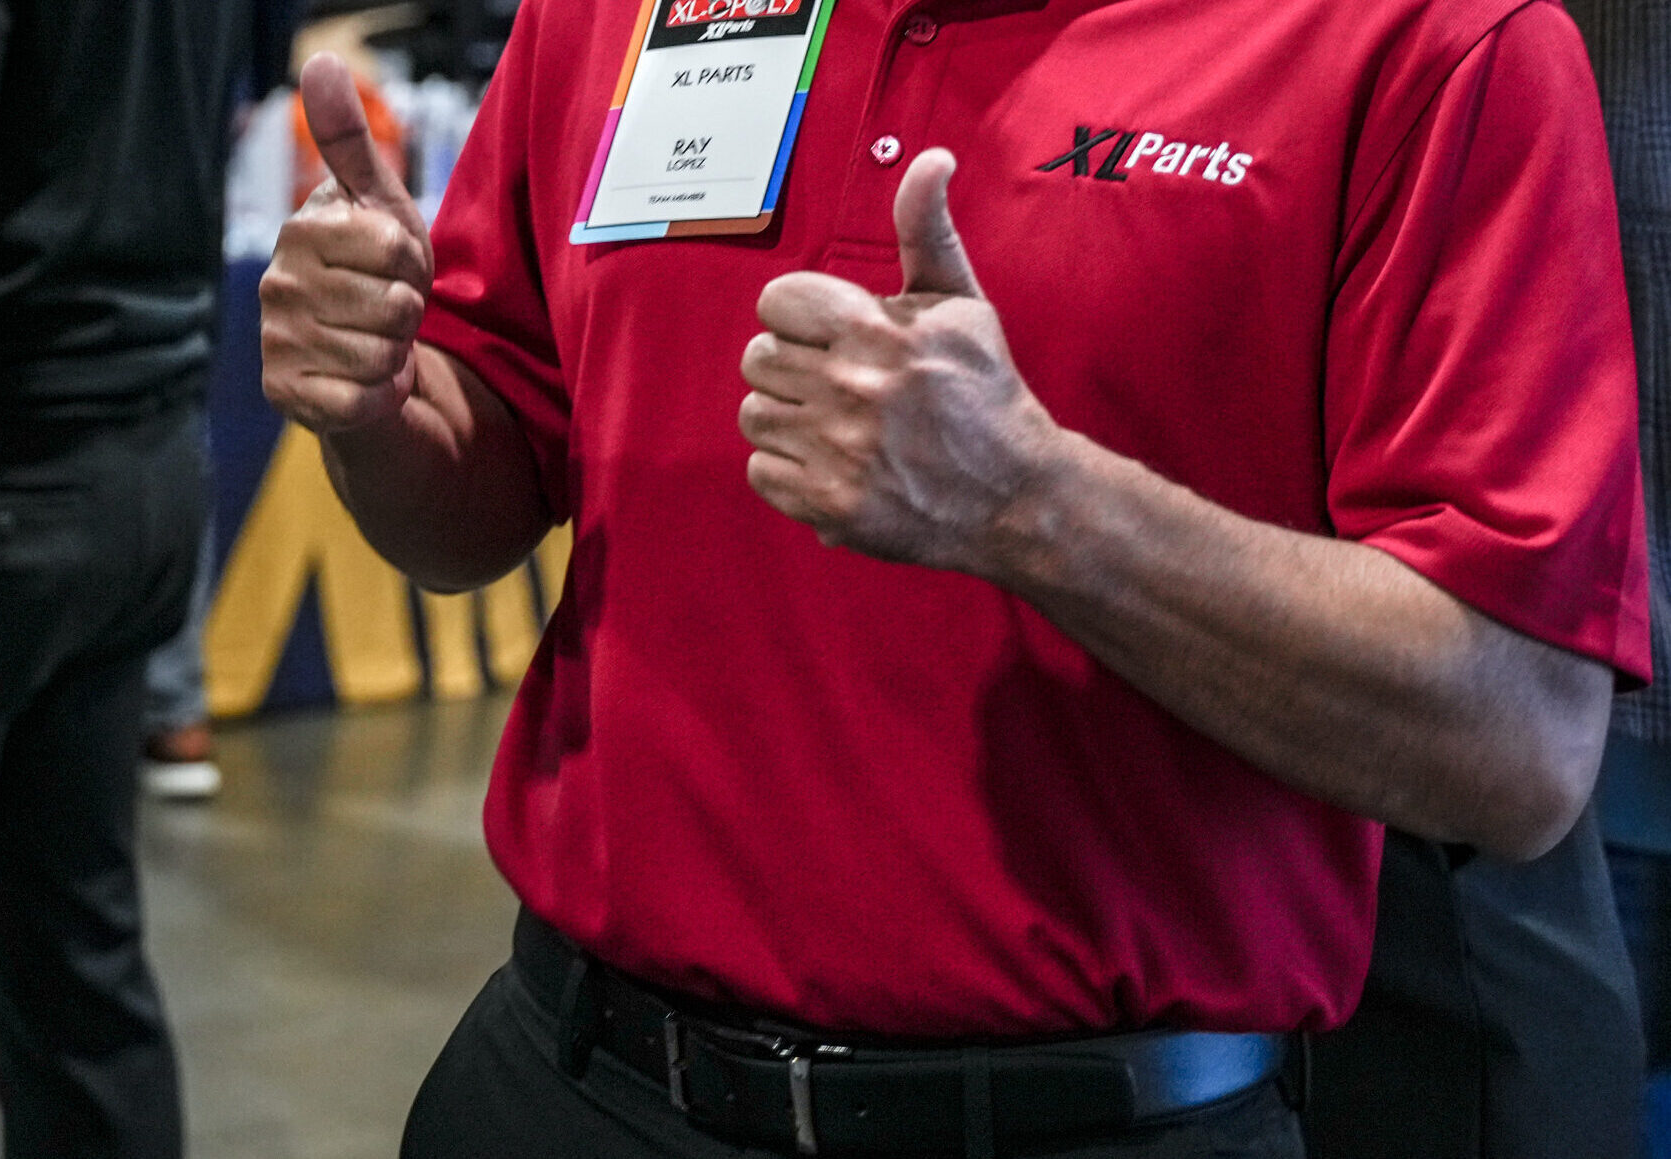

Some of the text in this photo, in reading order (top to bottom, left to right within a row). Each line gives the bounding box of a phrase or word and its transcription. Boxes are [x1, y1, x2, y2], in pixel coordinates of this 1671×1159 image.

[671, 64, 756, 88] XL PARTS
[672, 136, 713, 156] RAY
[666, 157, 708, 172] LOPEZ
